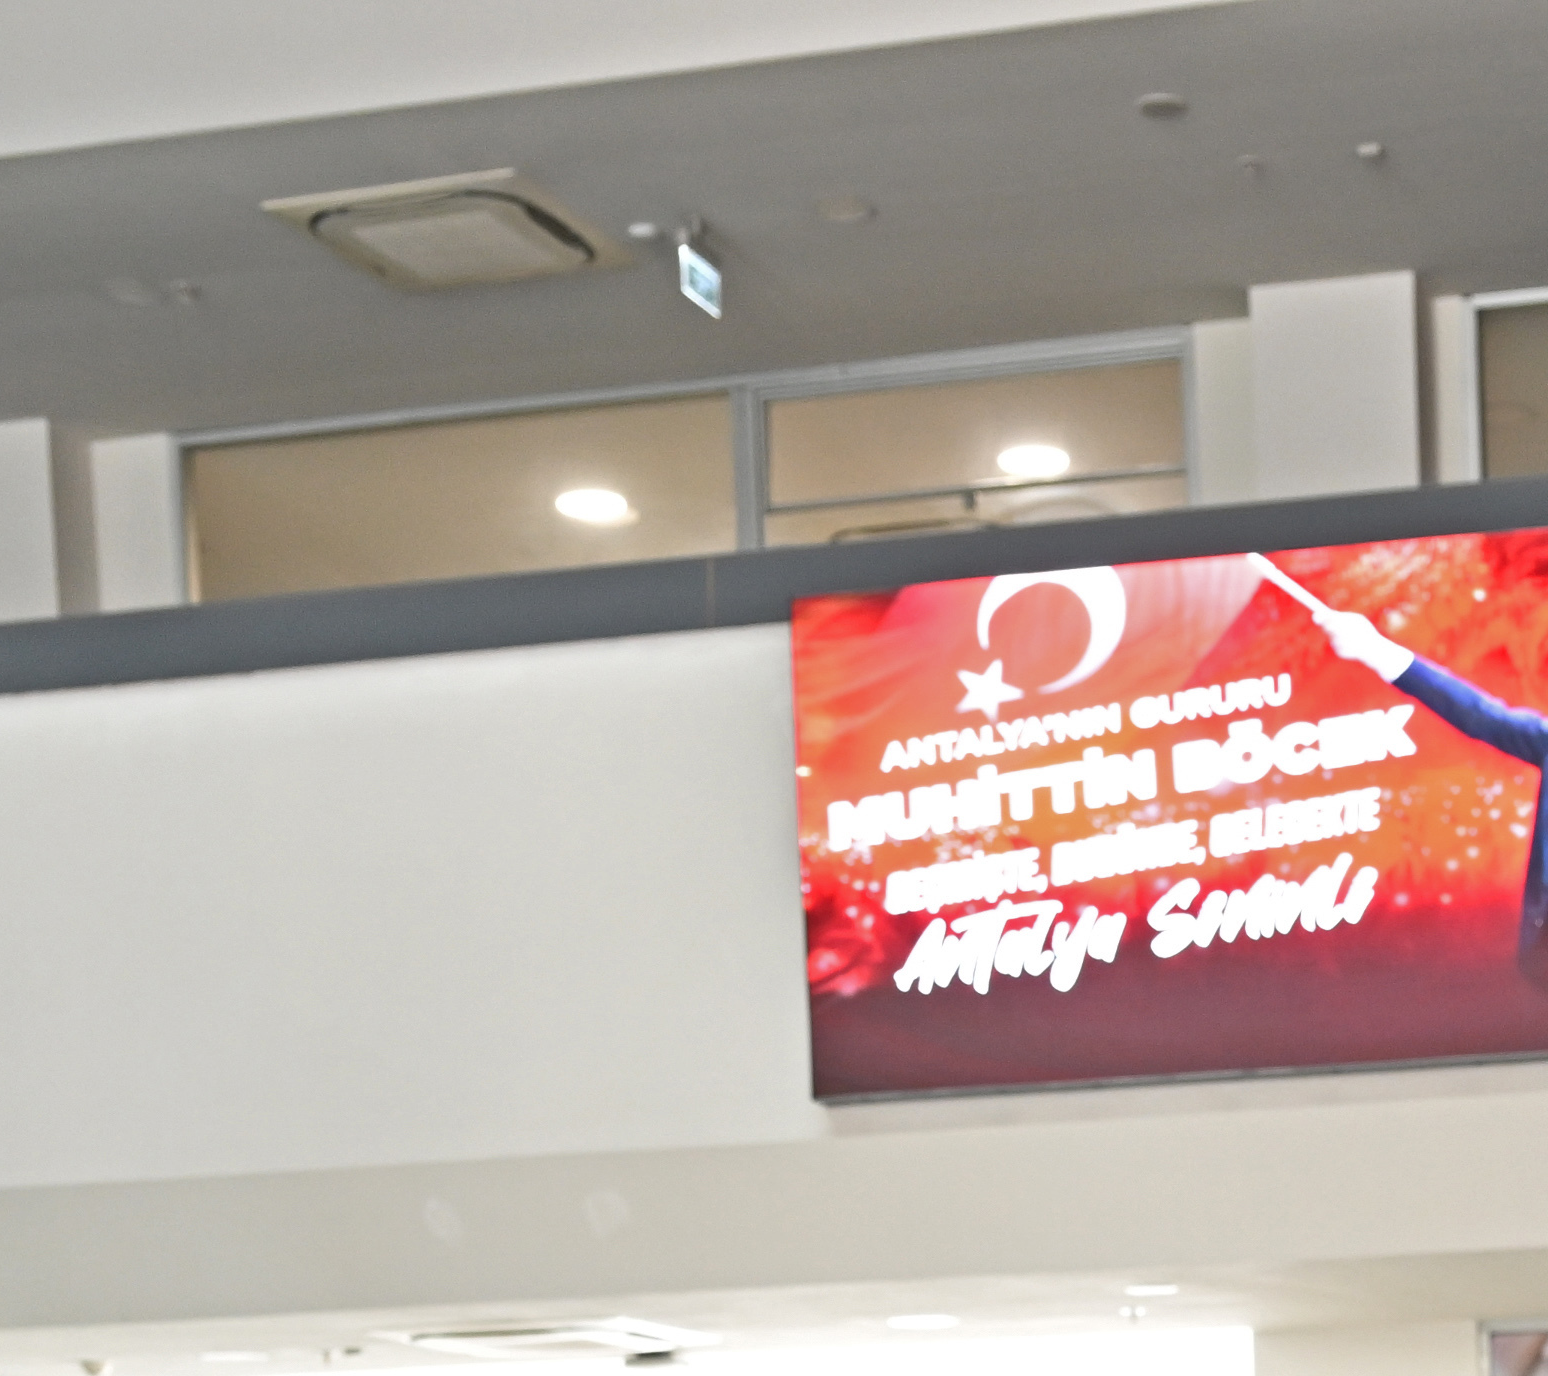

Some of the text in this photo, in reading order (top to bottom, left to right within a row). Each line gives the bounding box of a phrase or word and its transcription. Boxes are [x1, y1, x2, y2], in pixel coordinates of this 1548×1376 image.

[828, 705, 1416, 852] MUHİTTİN BÖCEK
[880, 673, 1292, 772] ANTALYA'NIN GURURU
